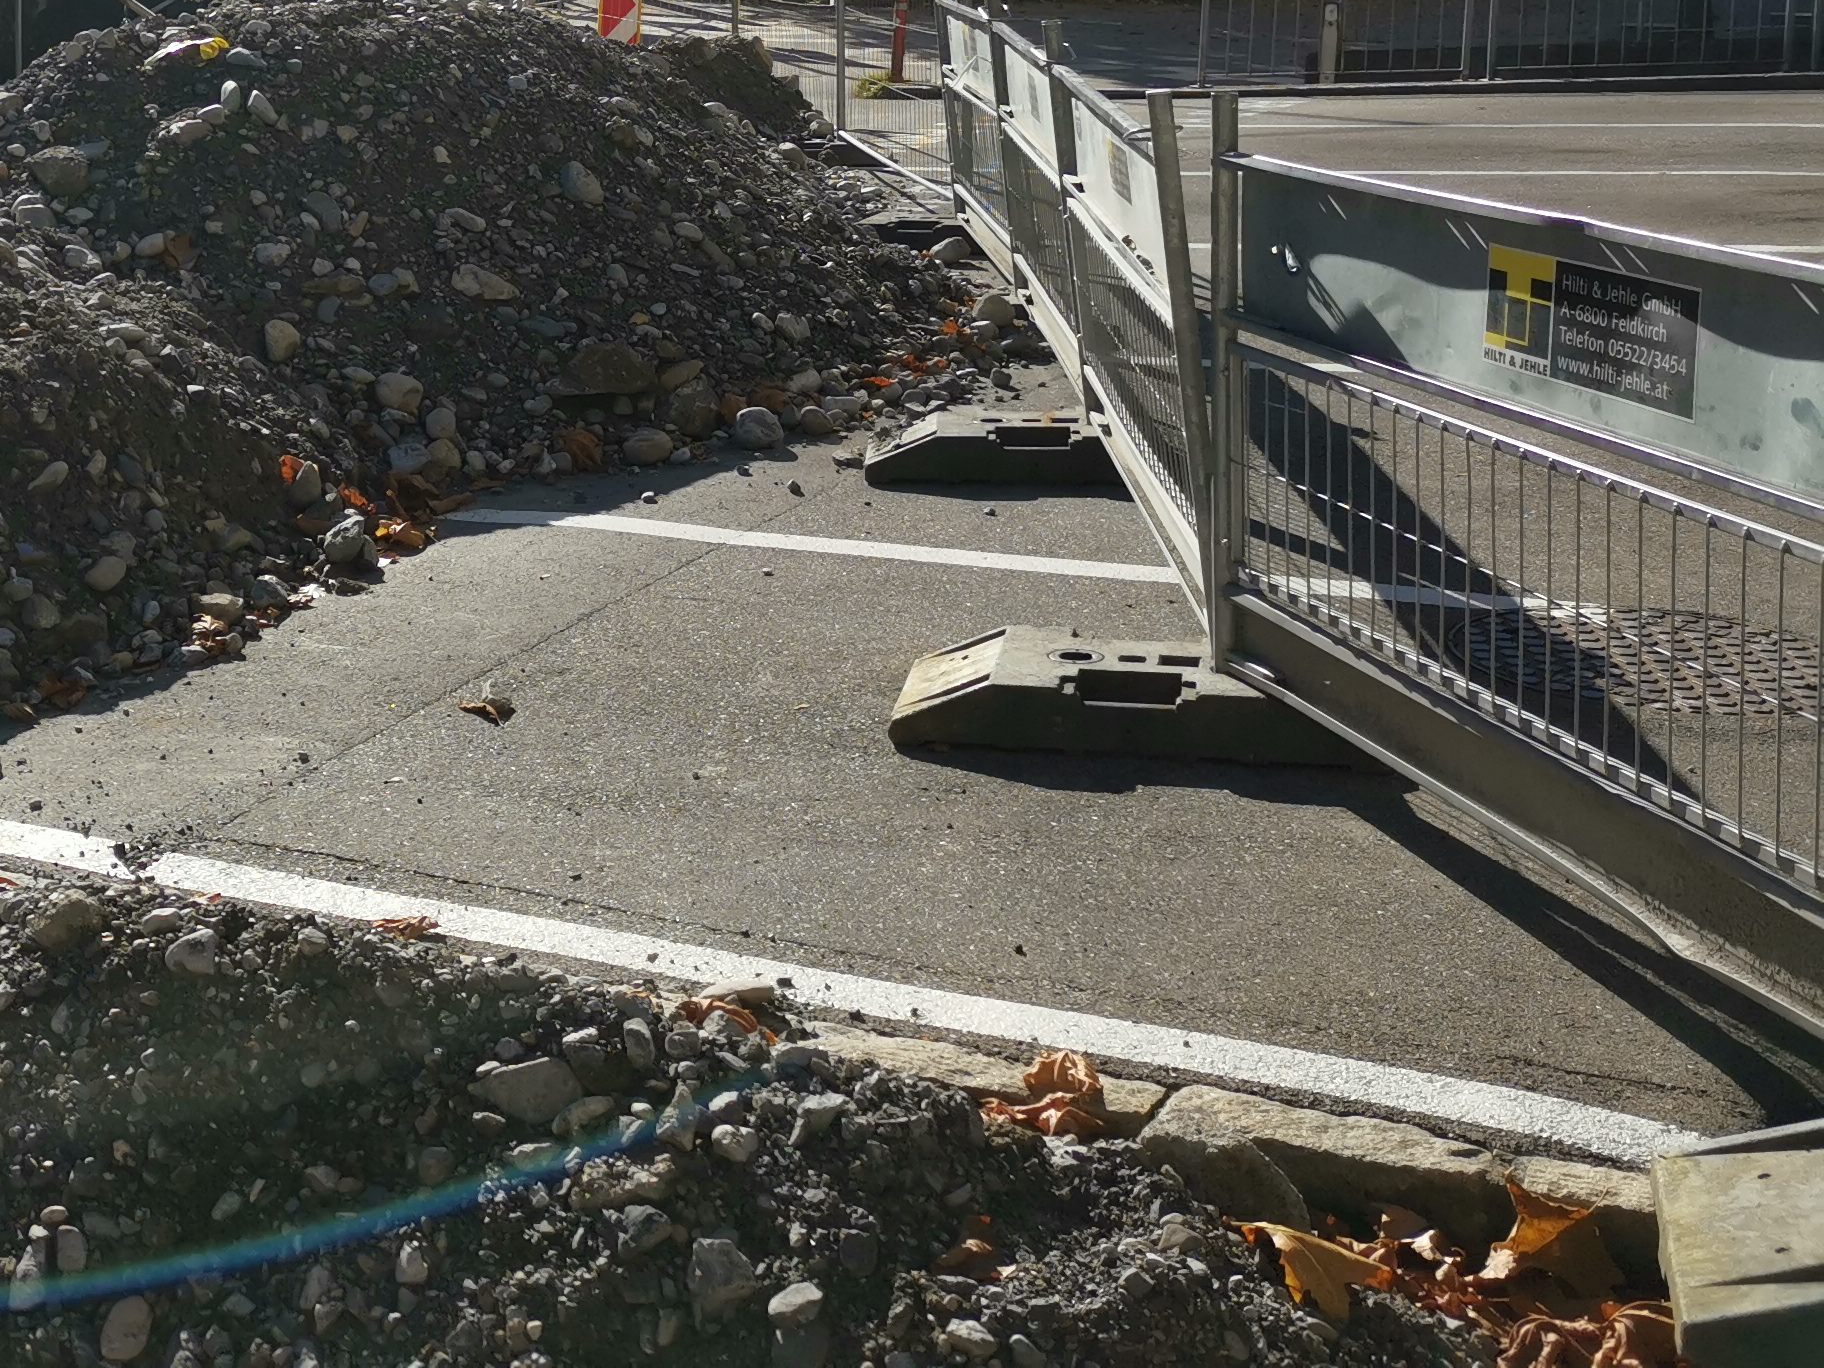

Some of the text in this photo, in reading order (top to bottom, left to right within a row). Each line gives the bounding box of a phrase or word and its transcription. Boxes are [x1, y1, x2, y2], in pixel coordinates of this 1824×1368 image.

[1562, 274, 1682, 319] Hilti & Jehle GmbH
[1560, 301, 1667, 343] A-6800 Feldkirch
[1483, 346, 1549, 377] HILTI & JEHLE
[1559, 325, 1687, 377] Telefon 05522/3454
[1557, 355, 1669, 401] www.hilti-jehle.at
